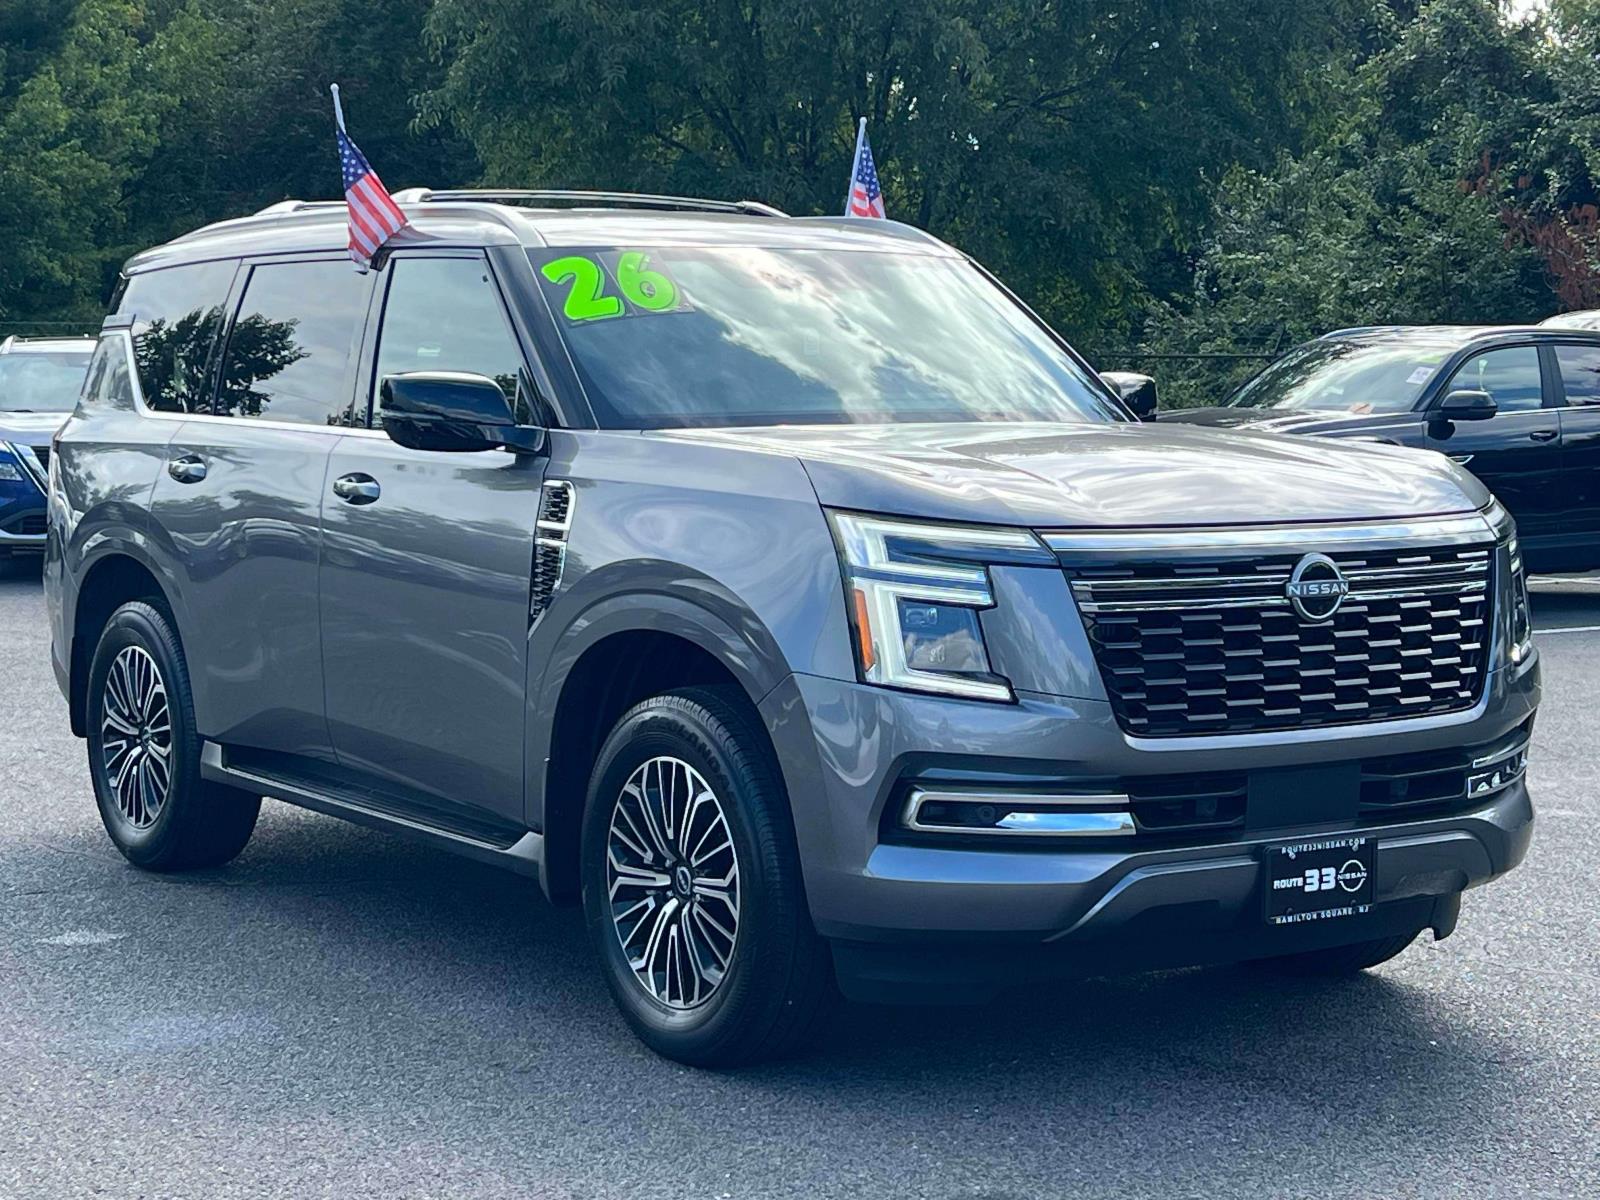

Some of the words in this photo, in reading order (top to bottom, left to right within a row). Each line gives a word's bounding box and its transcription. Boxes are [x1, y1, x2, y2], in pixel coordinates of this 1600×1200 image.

[541, 252, 681, 320] 26
[1288, 583, 1348, 595] NISSAN
[1282, 838, 1365, 854] ROUTE33NISSAN.COM
[1273, 877, 1303, 890] ROUTE
[1304, 867, 1336, 892] 33
[1337, 872, 1367, 880] NISSAN
[1275, 911, 1317, 924] HAMILTON
[1358, 905, 1369, 914] NJ
